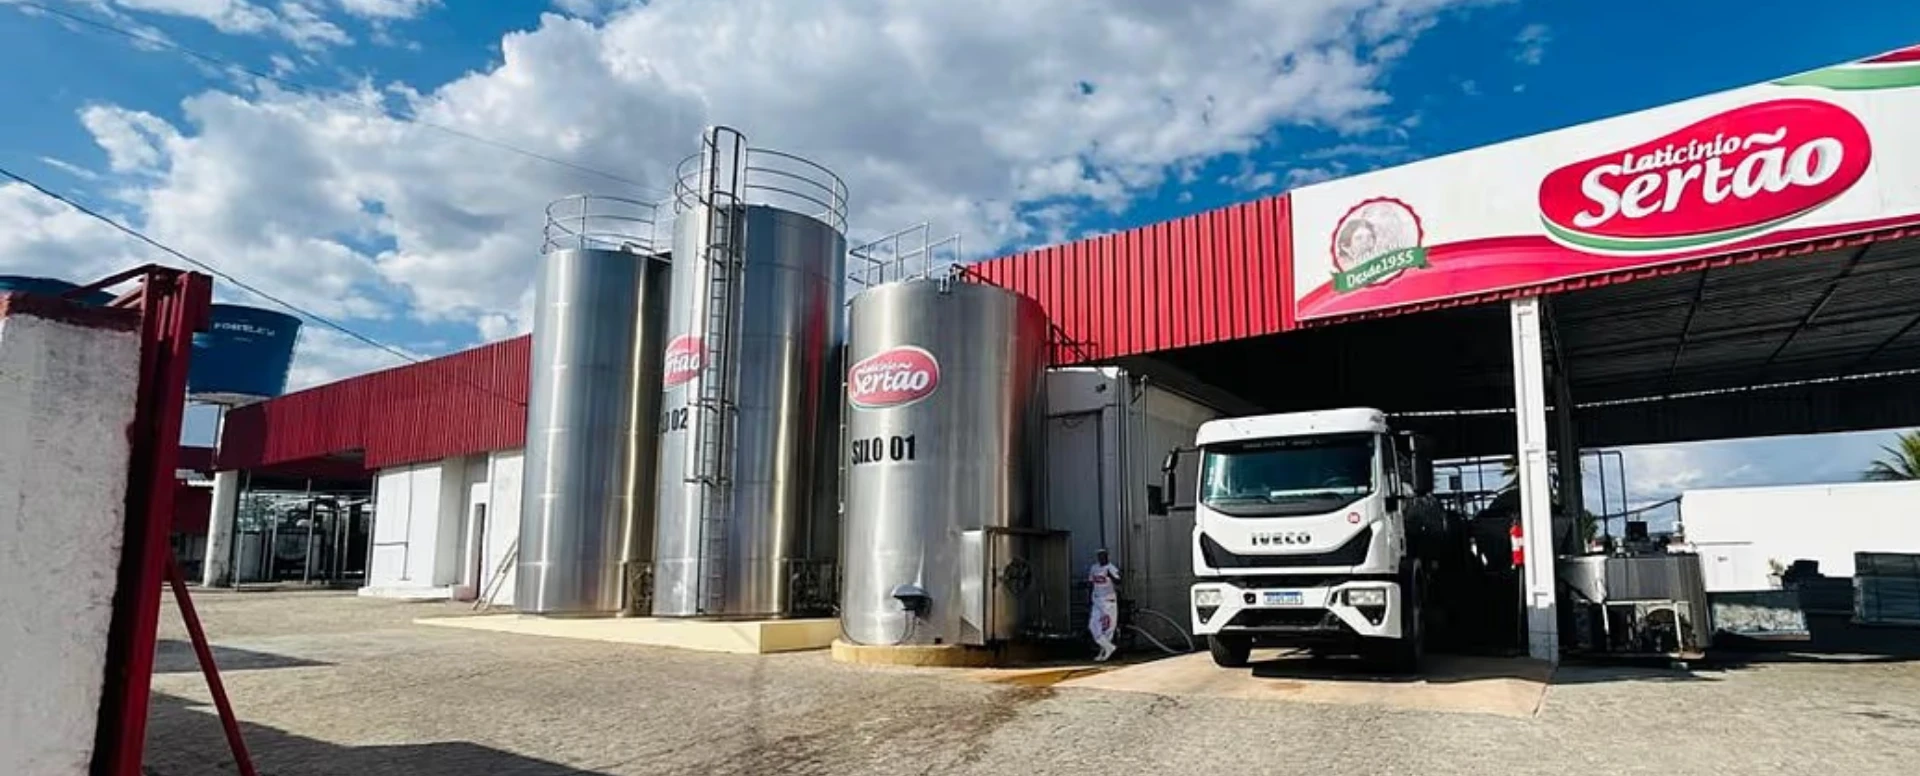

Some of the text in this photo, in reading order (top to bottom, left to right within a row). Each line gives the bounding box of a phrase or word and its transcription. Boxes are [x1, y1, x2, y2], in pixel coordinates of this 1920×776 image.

[1622, 132, 1742, 176] Laticínio
[1572, 126, 1845, 228] Sertão
[852, 361, 930, 397] Sertão
[670, 407, 688, 431] 02
[851, 434, 916, 465] SILO 01
[1251, 531, 1311, 547] IVECO
